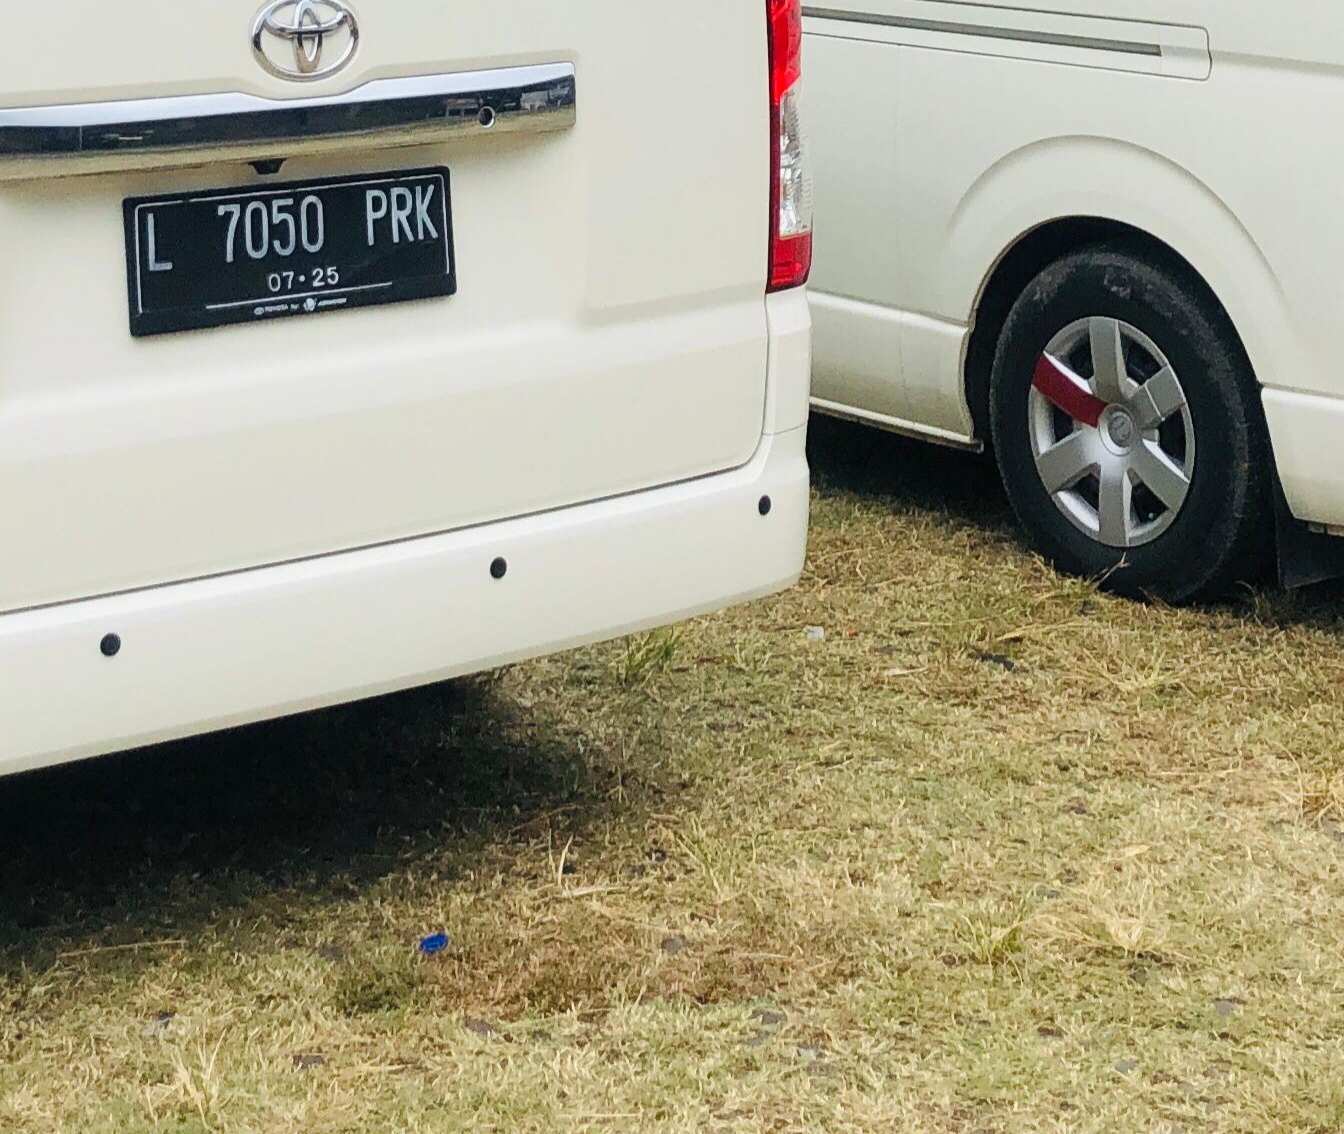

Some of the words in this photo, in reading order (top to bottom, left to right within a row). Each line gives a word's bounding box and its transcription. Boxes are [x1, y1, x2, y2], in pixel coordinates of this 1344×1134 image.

[147, 212, 174, 272] L
[217, 194, 325, 264] 7050
[365, 183, 440, 247] PRK
